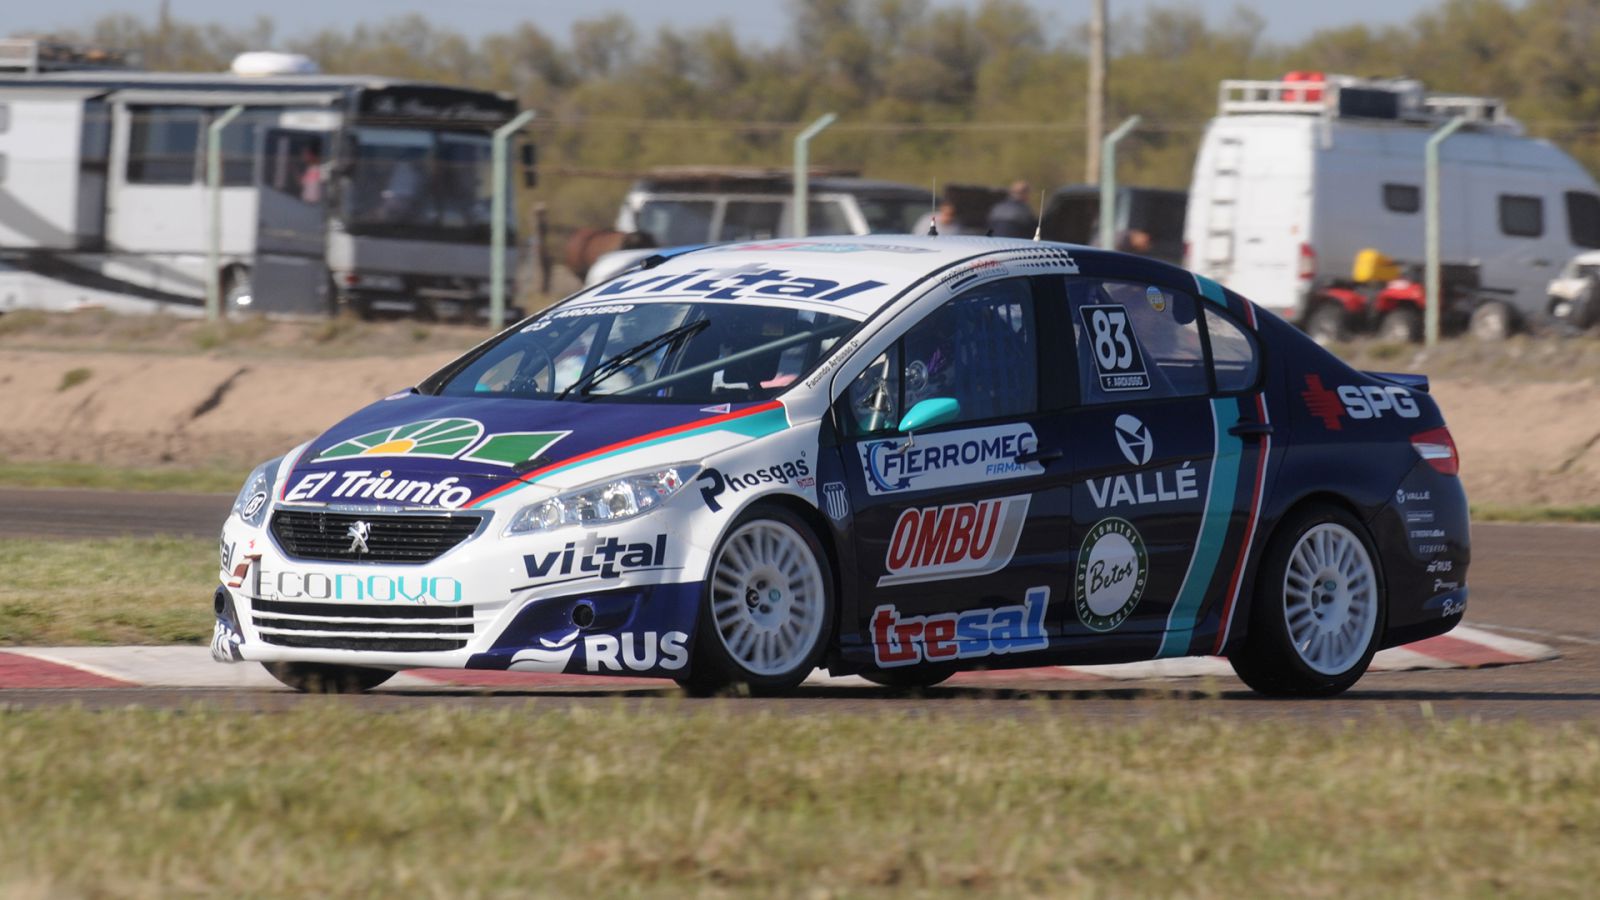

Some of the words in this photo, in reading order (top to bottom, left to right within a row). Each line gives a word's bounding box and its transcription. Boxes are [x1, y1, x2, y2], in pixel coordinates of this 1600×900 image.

[596, 262, 887, 302] vittal
[1092, 309, 1133, 370] 83
[1337, 385, 1420, 419] SPG
[285, 471, 336, 502] El
[331, 469, 472, 509] Triunfo
[696, 459, 810, 514] Phosgas
[1086, 461, 1199, 509] VALLÉ
[522, 531, 667, 580] vittal
[886, 500, 1003, 571] OMBU
[1090, 559, 1133, 595] Betos
[584, 630, 689, 673] RUS
[871, 587, 1050, 668] tresal
